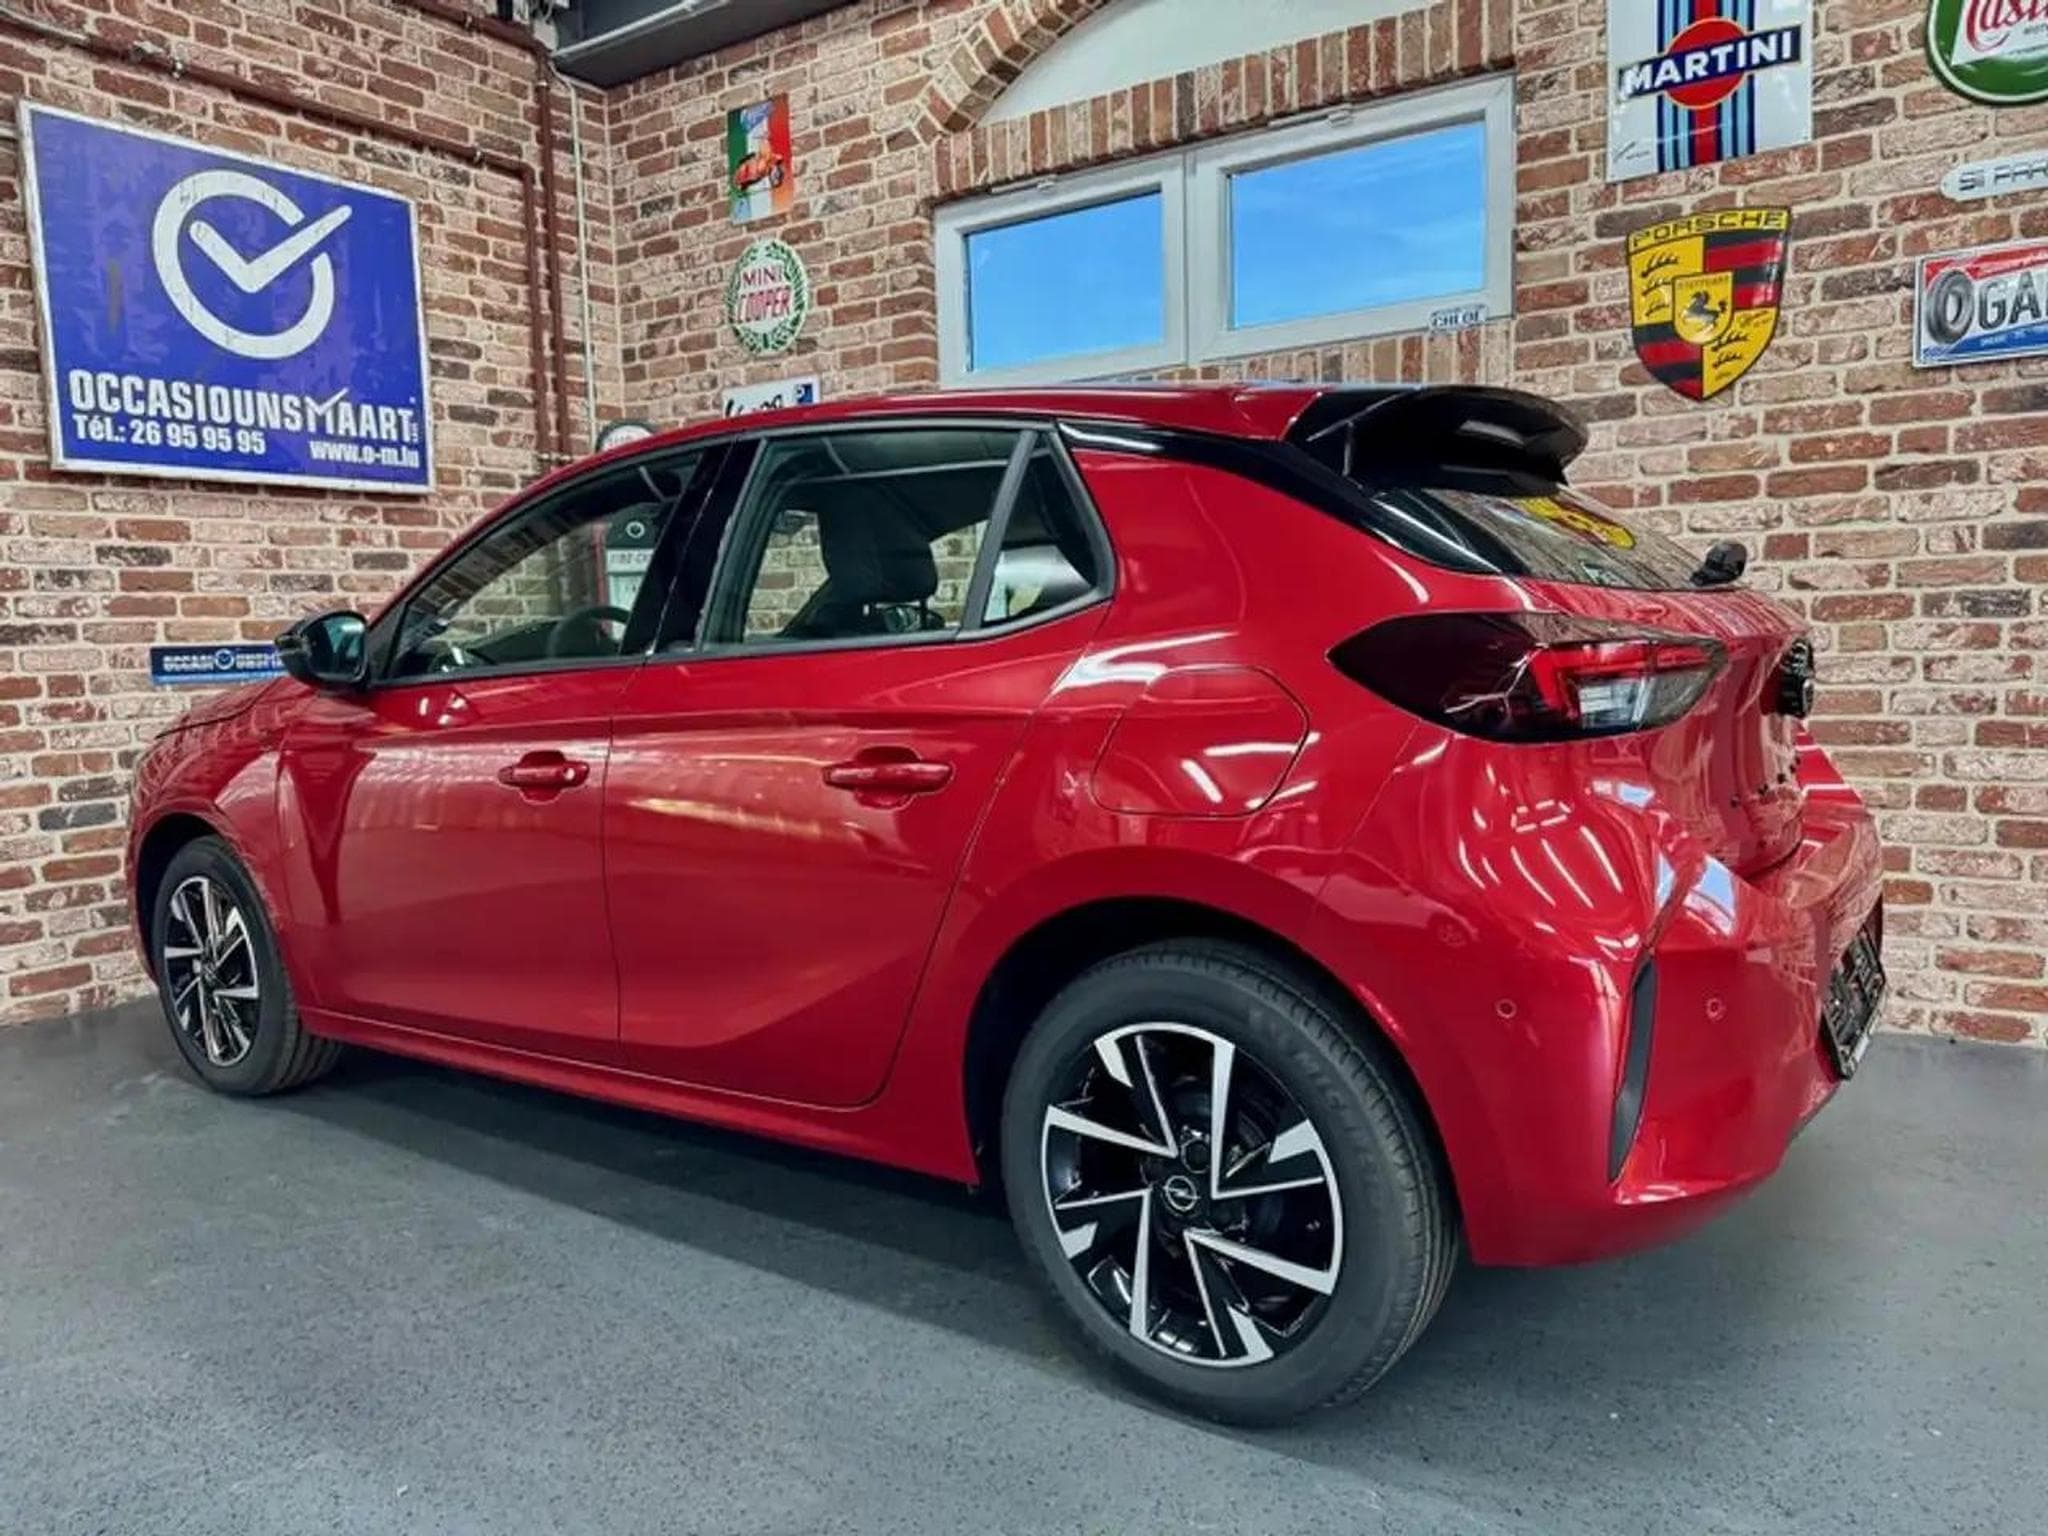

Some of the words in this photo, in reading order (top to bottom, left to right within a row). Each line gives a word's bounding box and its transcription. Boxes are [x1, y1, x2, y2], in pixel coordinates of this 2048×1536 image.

[1620, 30, 1793, 100] MARTINI
[1632, 211, 1784, 248] PORSCHE
[741, 263, 784, 287] MINI
[738, 286, 792, 323] COOPER
[73, 413, 127, 443] Tél.:
[130, 422, 162, 446] 26
[166, 425, 198, 451] 95
[203, 428, 233, 454] 95
[236, 431, 267, 455] 95
